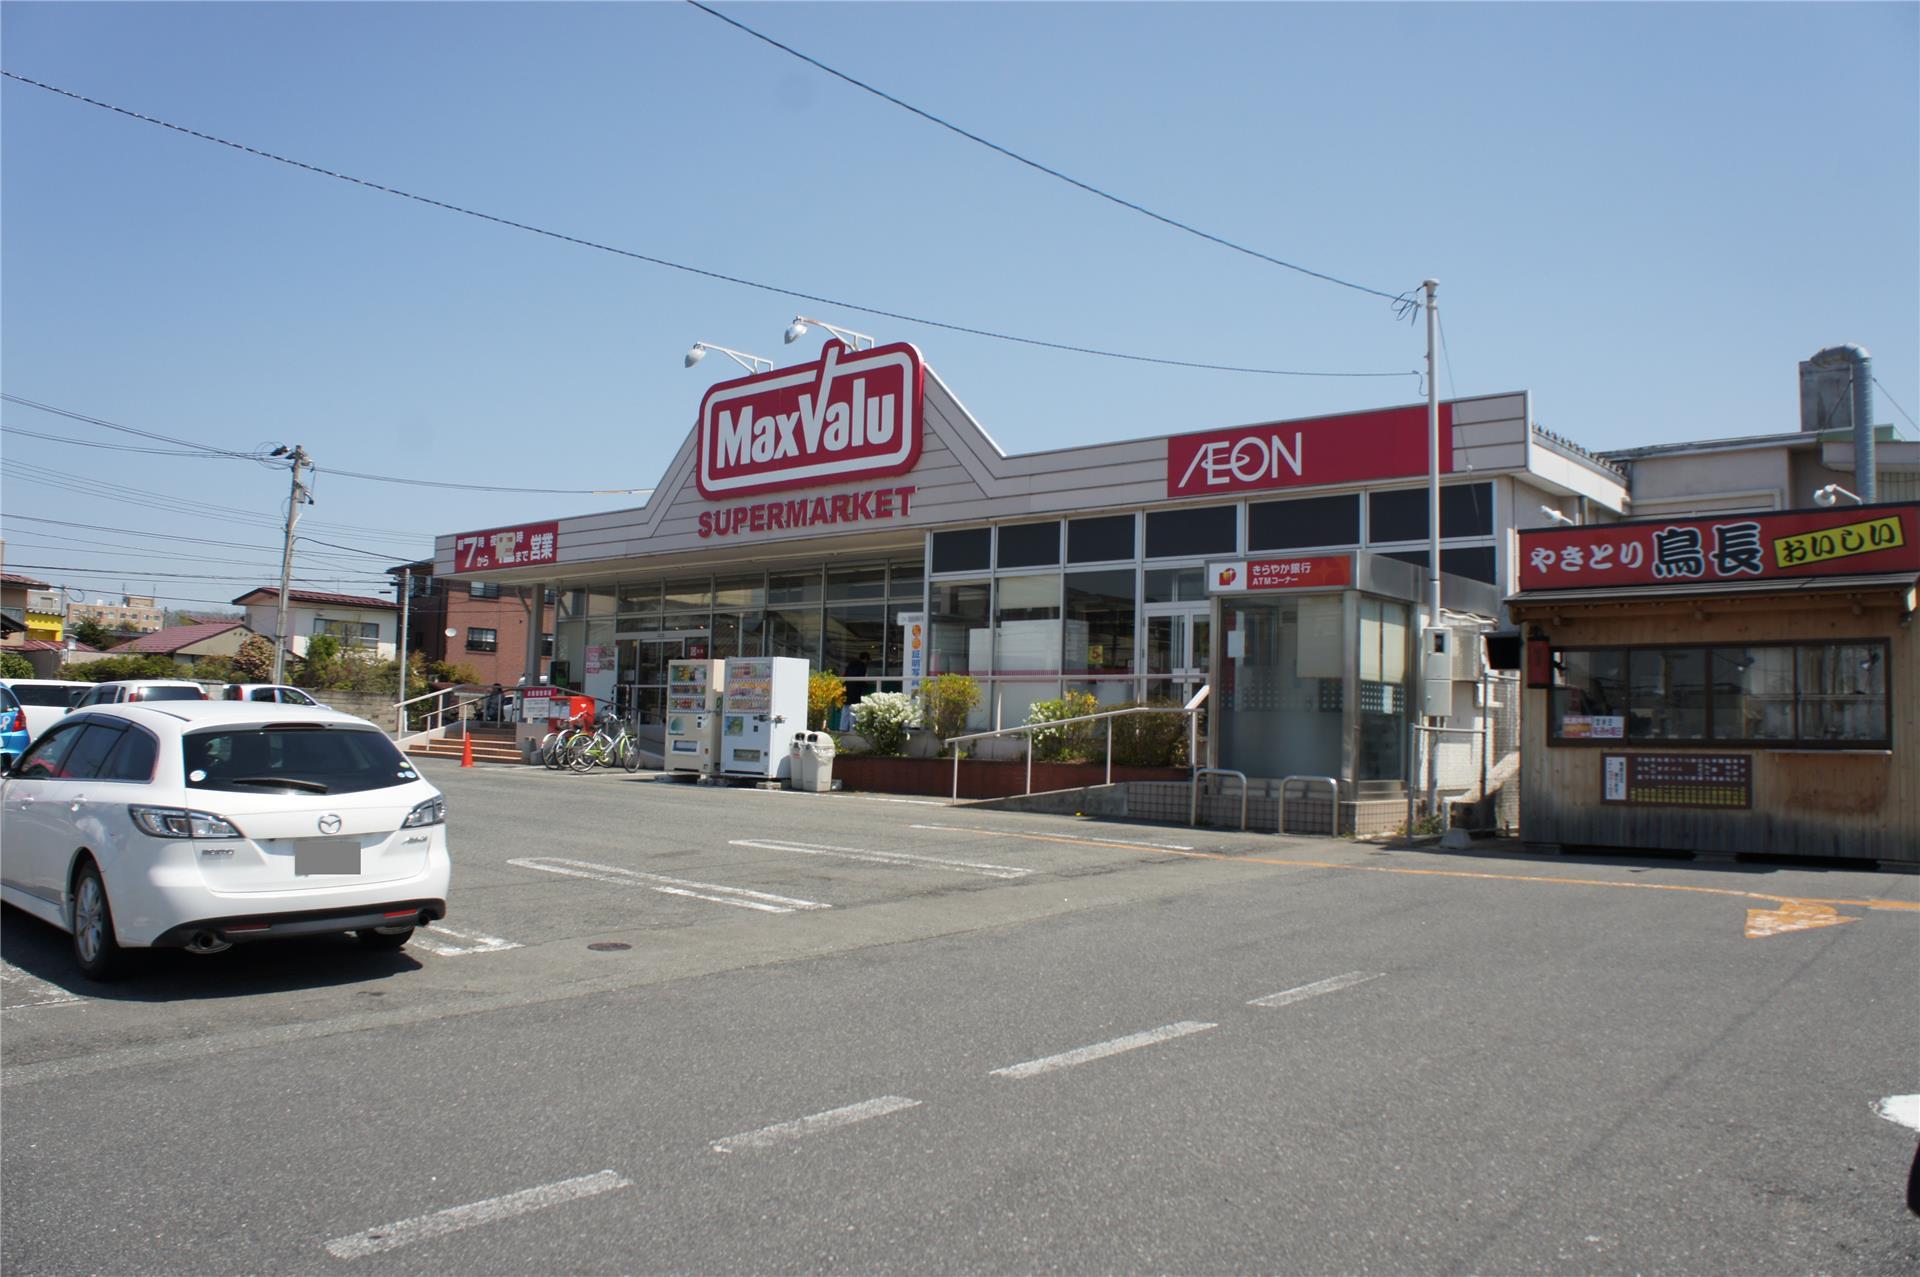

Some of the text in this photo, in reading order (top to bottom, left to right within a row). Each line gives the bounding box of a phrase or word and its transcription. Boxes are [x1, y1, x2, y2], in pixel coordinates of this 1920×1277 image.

[715, 346, 896, 469] MaxValu
[697, 485, 918, 539] SUPERMARKET
[1252, 562, 1312, 577] きらやか銀行
[1529, 521, 1897, 579] やきとり 鳥長 おいしい
[1252, 576, 1299, 587] ATMコーナー
